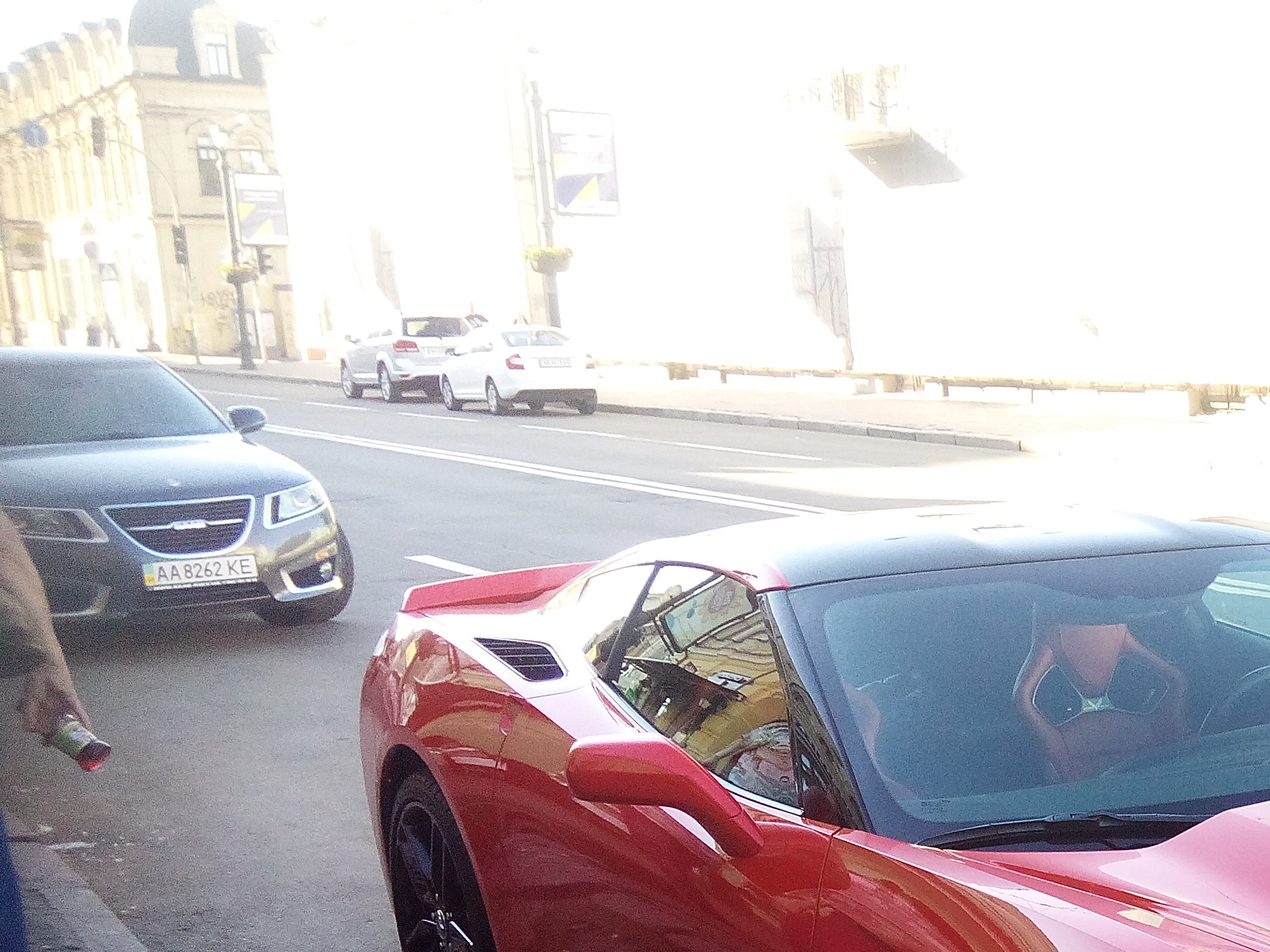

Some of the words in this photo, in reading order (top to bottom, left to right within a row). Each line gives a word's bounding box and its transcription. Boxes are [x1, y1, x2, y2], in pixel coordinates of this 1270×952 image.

[158, 566, 182, 582] AA
[184, 562, 222, 579] 8262
[227, 559, 252, 576] KE
